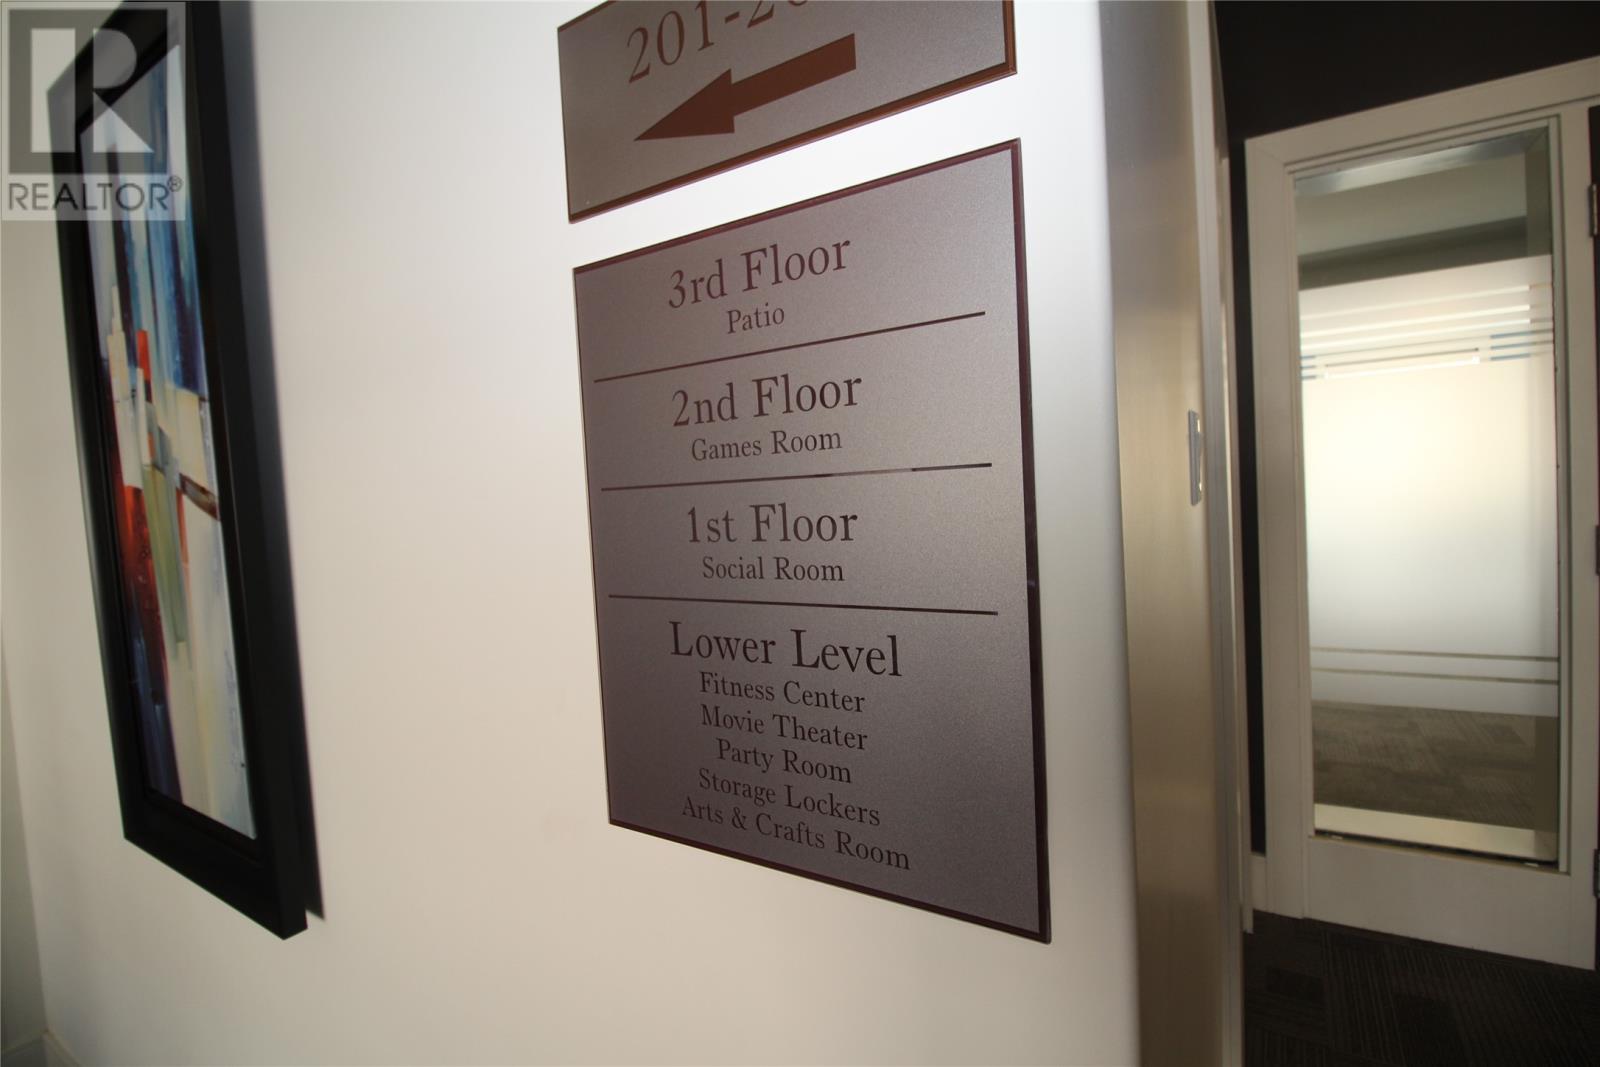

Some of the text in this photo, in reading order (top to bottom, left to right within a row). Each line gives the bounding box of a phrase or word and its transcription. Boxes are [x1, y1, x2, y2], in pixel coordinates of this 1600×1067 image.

[626, 0, 808, 83] 201-2
[668, 239, 851, 309] 3rd Floor
[726, 302, 786, 335] Patio
[671, 373, 863, 427] 2nd Floor
[691, 430, 843, 462] Games Room
[687, 502, 859, 543] 1st Floor
[702, 556, 846, 582] Social Room
[668, 621, 903, 678] Lower Level
[699, 671, 866, 713] Fitness Center
[700, 703, 869, 751] Movie Theater
[715, 737, 853, 784] Party Room
[699, 767, 881, 827] Storage Lockers
[681, 795, 911, 871] Arts & Crafts Room
